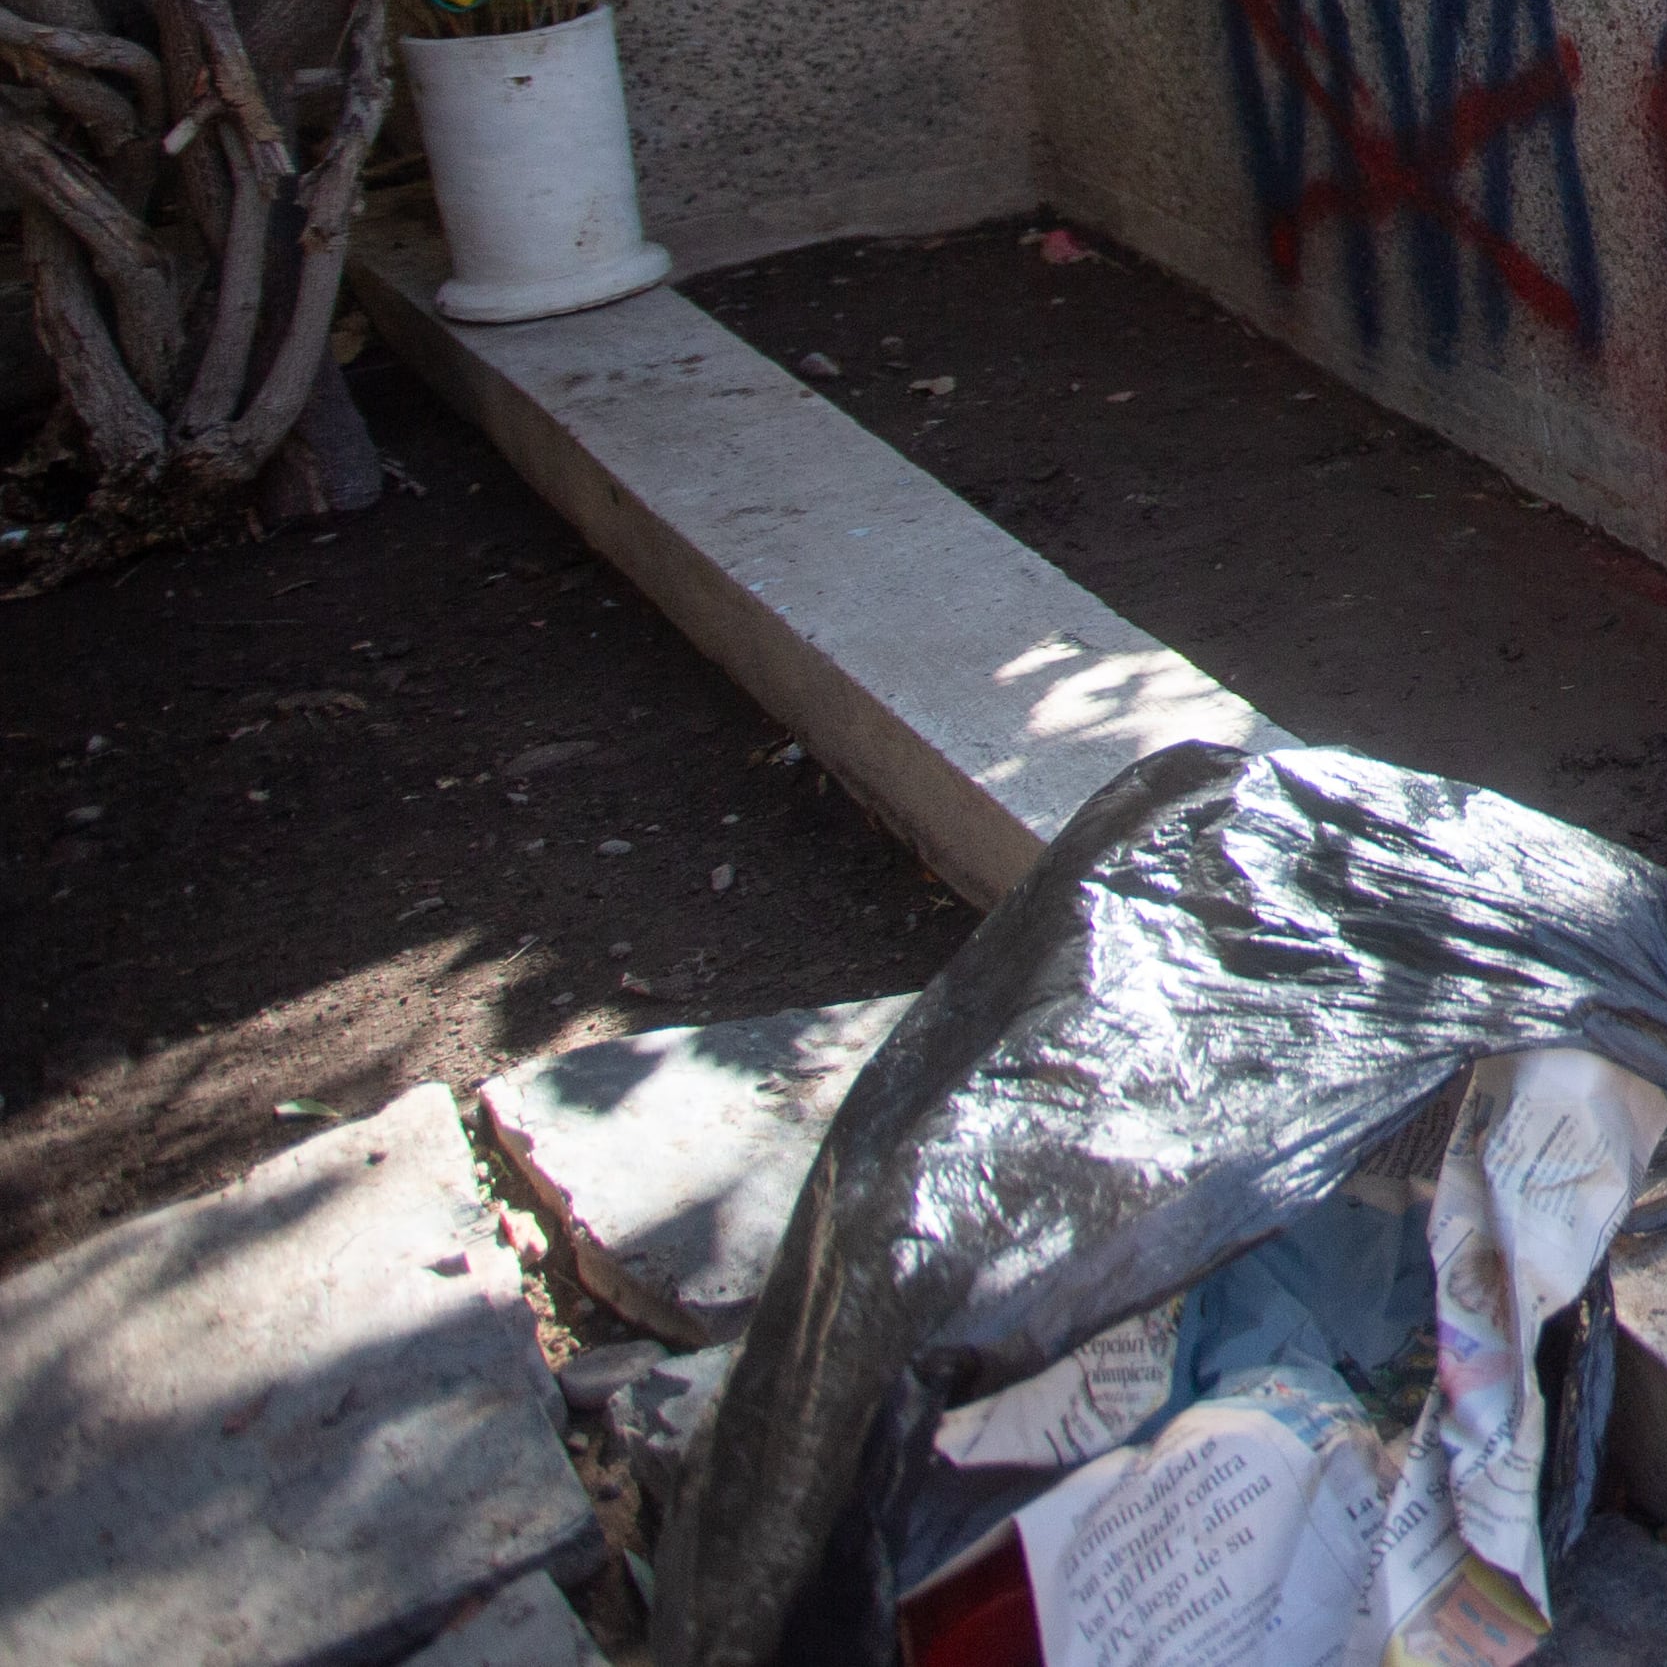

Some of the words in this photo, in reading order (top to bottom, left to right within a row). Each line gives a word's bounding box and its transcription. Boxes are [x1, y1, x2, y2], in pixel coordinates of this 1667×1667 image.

[1184, 1453, 1248, 1508] contra
[1203, 1473, 1273, 1534] afirma
[1193, 1546, 1222, 1577] de
[1225, 1526, 1255, 1555] su
[1156, 1575, 1232, 1645] central
